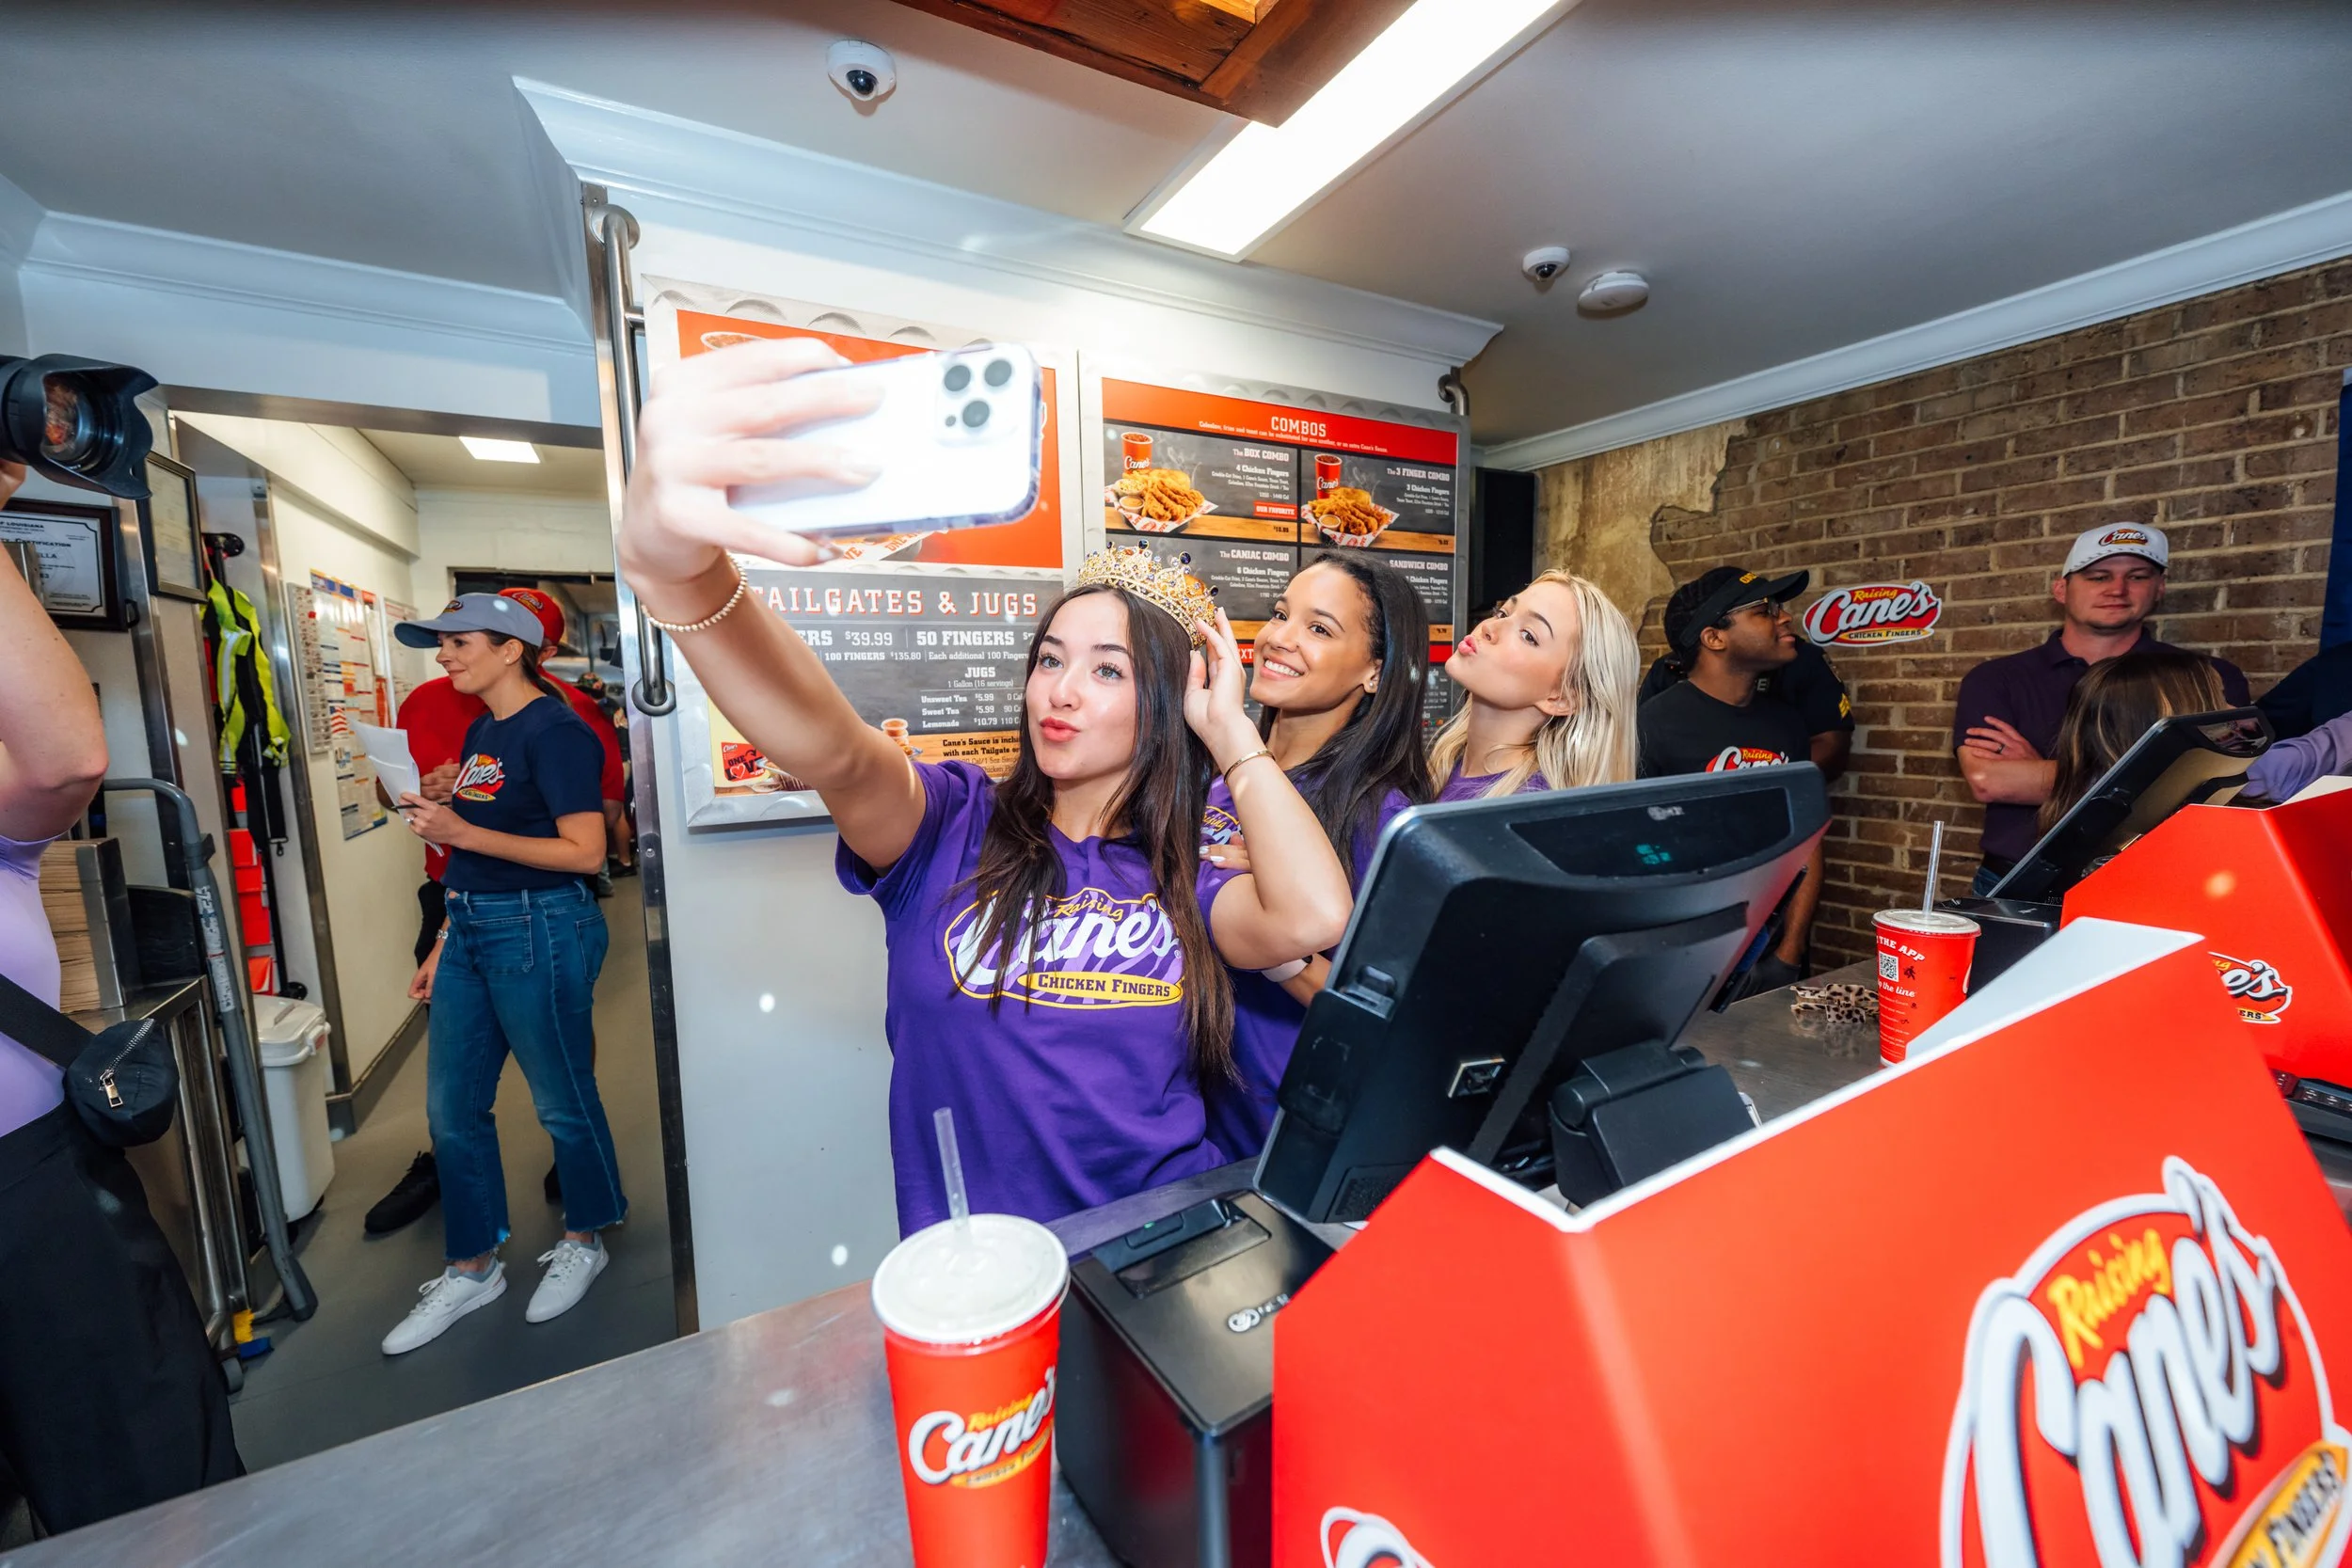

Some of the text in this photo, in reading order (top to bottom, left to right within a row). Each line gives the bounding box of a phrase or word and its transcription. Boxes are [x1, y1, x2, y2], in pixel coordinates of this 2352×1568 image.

[1271, 416, 1327, 437] COMBOS
[1244, 448, 1261, 459] BOX
[1262, 451, 1290, 462] COMBO
[1242, 465, 1265, 475] Chicken
[1266, 467, 1289, 478] Fingers
[1396, 467, 1401, 476] 3
[1402, 467, 1426, 479] FINGER
[1428, 471, 1450, 482] COMBO
[1411, 483, 1431, 493] Chicken
[1431, 486, 1450, 496] Fingers
[1268, 506, 1295, 515] FAVORITE
[1231, 549, 1261, 560] CANIAC
[1263, 551, 1290, 562] COMBO
[1243, 566, 1266, 575] Chicken
[1267, 568, 1290, 578] Fingers
[1389, 560, 1449, 571] SANDWICH COMBO
[1852, 588, 1899, 602] Raising
[938, 591, 959, 615] &
[970, 591, 1038, 617] JUGS
[1809, 582, 1937, 642] Cane's
[845, 631, 893, 646] $39.99
[916, 630, 937, 646] 50
[942, 630, 1015, 646] FINGERS
[1848, 629, 1921, 639] CHICKEN FINGERS
[824, 652, 842, 660] 100
[844, 652, 885, 660] FINGERS
[890, 651, 921, 660] $135.80
[929, 652, 946, 660] Each
[948, 651, 985, 660] additional
[987, 651, 1002, 659] 100
[964, 666, 996, 677] JUGS
[974, 679, 985, 689] (16
[987, 678, 1014, 689] servings)
[921, 695, 952, 704] Unsweet
[975, 693, 994, 702] $5.99
[922, 707, 945, 716] Sweet
[975, 705, 994, 714] $5.99
[922, 720, 960, 728] Lemonade
[943, 738, 966, 747] Cane's
[968, 737, 991, 746] Sauce
[943, 749, 960, 757] with
[980, 747, 1009, 756] Tailgate
[1741, 749, 1772, 761] Raising
[1054, 895, 1123, 922] Raising
[1879, 936, 1926, 961] THE APP
[1038, 974, 1170, 997] CHICKEN FINGERS
[1883, 981, 1895, 992] the
[1895, 986, 1916, 998] line
[2046, 1227, 2170, 1370] Raising
[1973, 1169, 2282, 1568] Cane's
